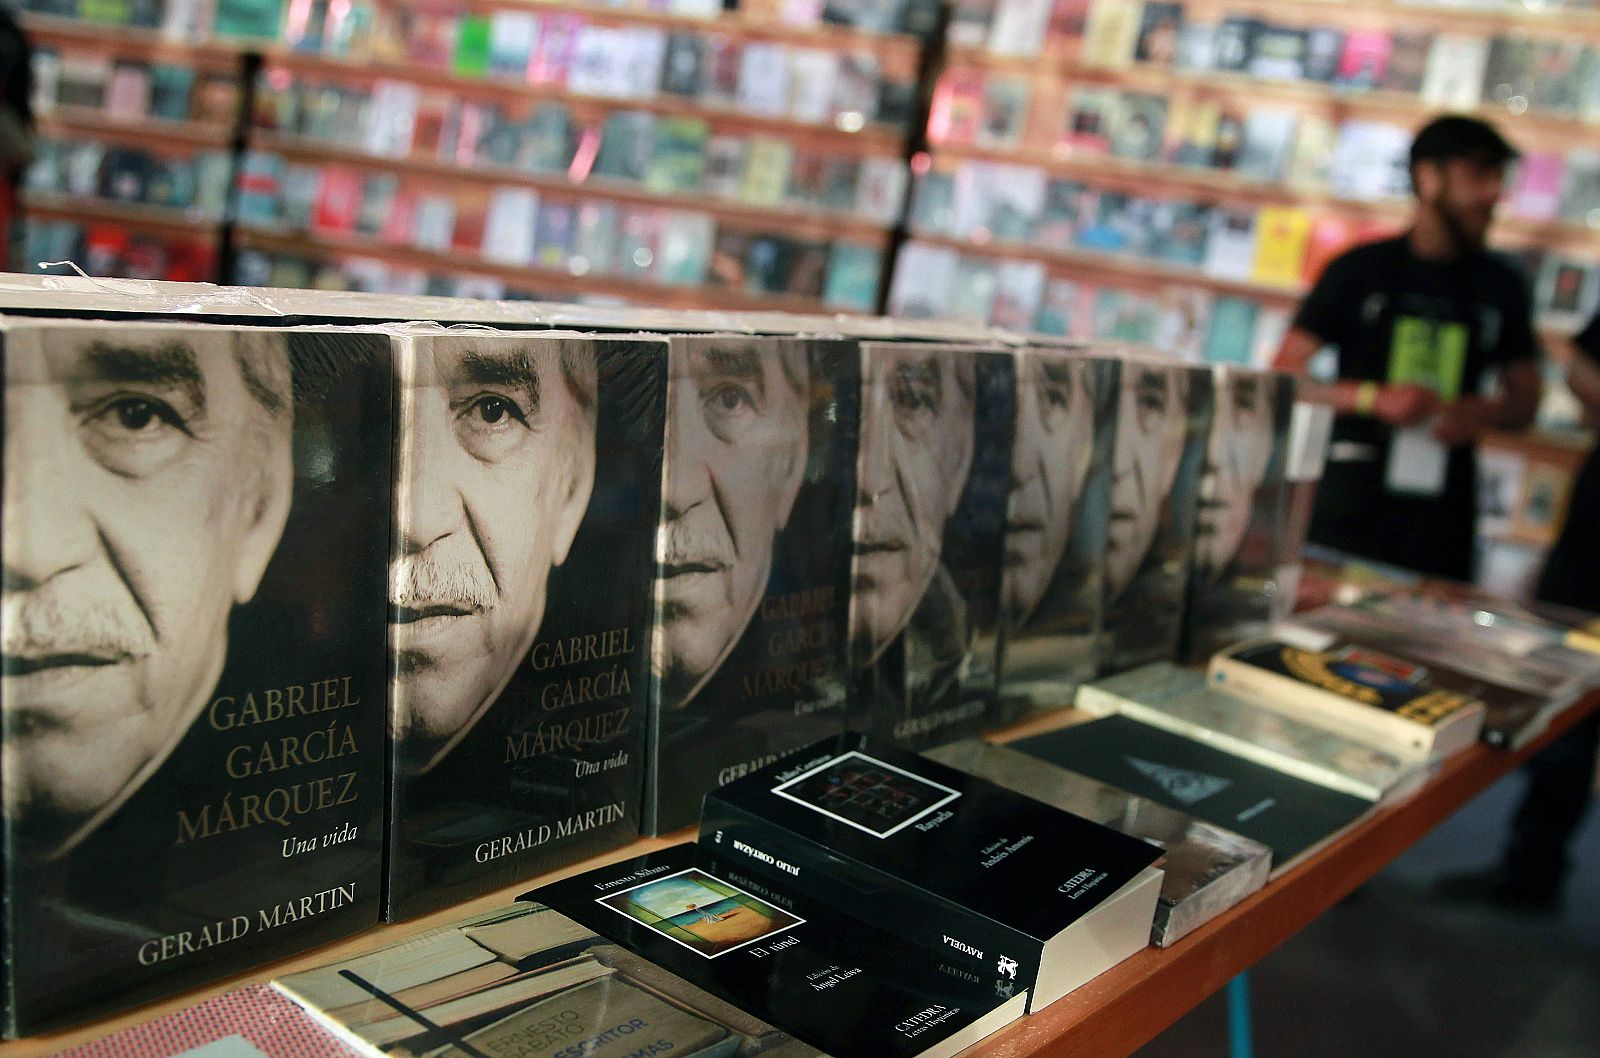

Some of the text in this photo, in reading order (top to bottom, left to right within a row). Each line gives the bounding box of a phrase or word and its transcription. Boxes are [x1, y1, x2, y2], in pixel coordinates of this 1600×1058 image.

[531, 628, 635, 671] GABRIEL
[209, 677, 360, 732] GABRIEL
[541, 664, 631, 711] GARCÍA
[225, 720, 359, 779] GARCÍA
[504, 708, 630, 763] MÁRQUEZ
[575, 750, 629, 778] Una vida
[175, 771, 359, 844] MÁRQUEZ
[914, 811, 954, 832] Rayuela
[282, 822, 358, 858] Una vida
[475, 801, 626, 863] GERALD MARTIN
[593, 865, 671, 891] Ernesto Sábato
[733, 839, 801, 877] JULIO CORTÁZAR
[138, 882, 357, 966] GERALD MARTIN
[749, 936, 801, 958] El túnel
[942, 934, 984, 960] RAYUELA
[486, 1011, 579, 1051] ERNESTO
[553, 1018, 649, 1058] ESCRITOR
